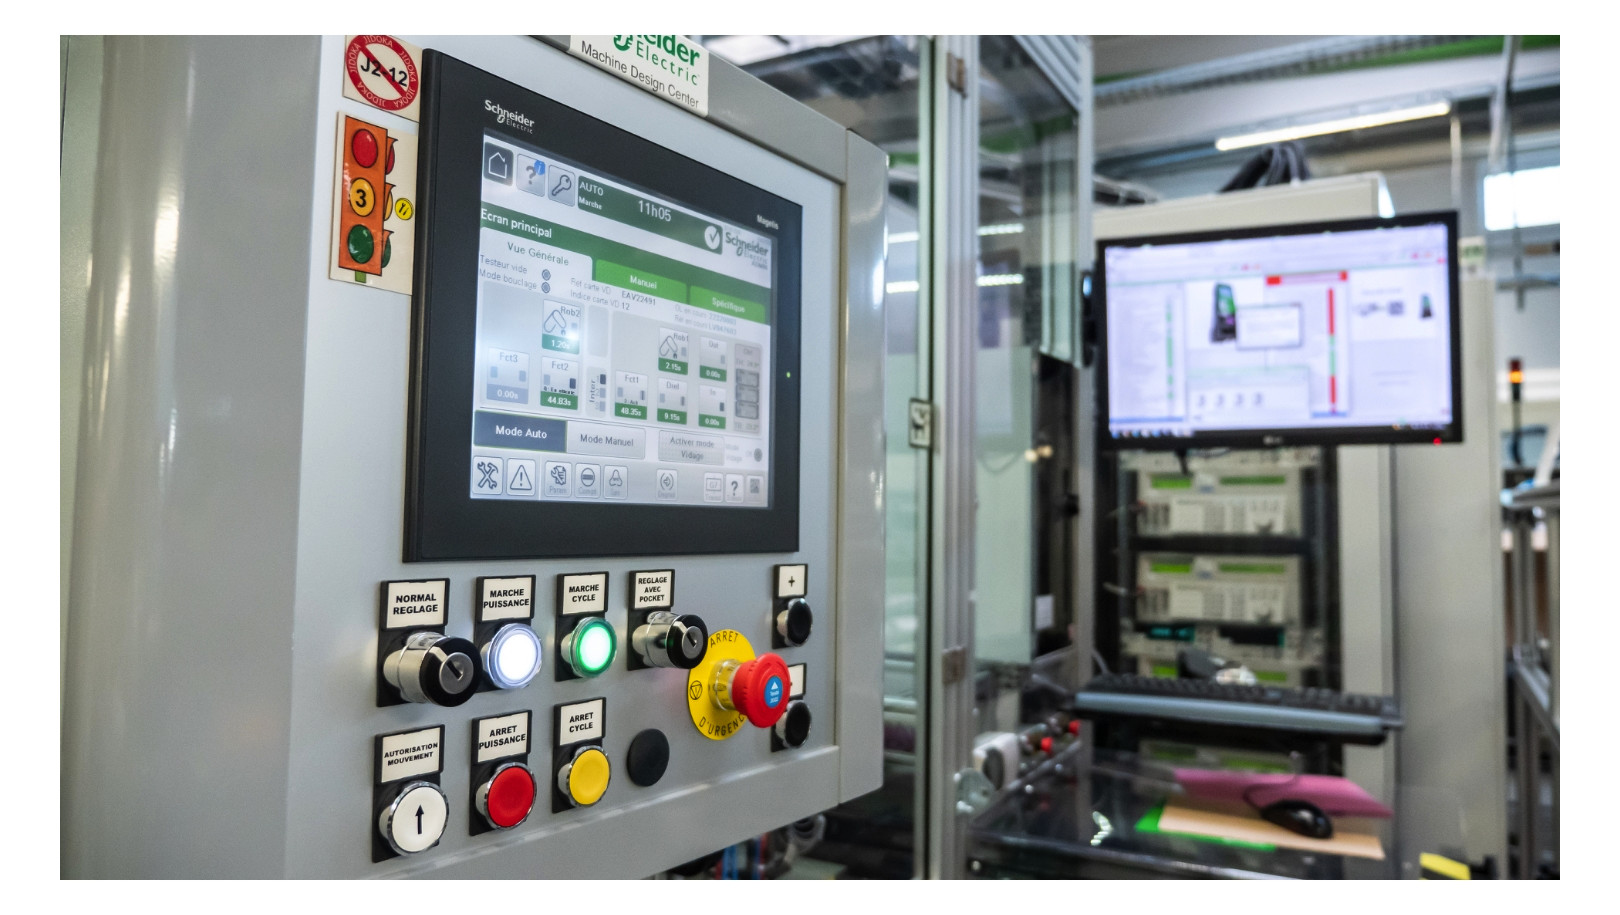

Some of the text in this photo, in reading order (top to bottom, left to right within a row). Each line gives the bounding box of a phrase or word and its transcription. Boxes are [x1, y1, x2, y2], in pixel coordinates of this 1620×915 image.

[363, 35, 393, 48] JIDOKA
[348, 43, 361, 73] JIDOKA
[637, 35, 700, 66] eider
[399, 51, 417, 82] JIDOKA
[636, 40, 698, 86] Electric
[581, 40, 699, 109] Machine Design Center
[357, 81, 386, 107] JIDOKA
[393, 86, 416, 107] JIDOKA
[484, 99, 535, 128] Schneider
[506, 118, 534, 135] Electric
[579, 181, 604, 196] AUTO
[355, 189, 367, 208] 3
[578, 196, 603, 210] Marche
[638, 199, 672, 222] 11h05
[511, 218, 553, 239] principal
[725, 231, 769, 257] Schneider
[507, 242, 569, 266] Vue Générale
[480, 254, 528, 274] Testeur vide
[479, 269, 537, 290] Mode bouclage
[629, 274, 657, 290] Manuel
[621, 302, 631, 310] 12
[495, 425, 548, 439] Mode Auto
[580, 434, 634, 447] Mode Manuel
[696, 440, 714, 448] mode
[568, 584, 599, 593] MARCHE
[638, 577, 667, 585] REGLAGE
[395, 593, 437, 604] NORMAL
[489, 588, 525, 598] MARCHE
[572, 594, 596, 602] CYCLE
[639, 594, 665, 603] POCKET
[393, 604, 438, 615] REGLAGE
[483, 598, 530, 609] PUISSANCE
[710, 630, 738, 648] ARRET
[569, 712, 594, 724] ARRET
[699, 713, 745, 737] D'URGENC
[489, 725, 518, 738] ARRET
[569, 721, 594, 733] CYCLE
[478, 733, 526, 750] PUISSANCE
[384, 742, 438, 758] AUTORISATION
[387, 751, 434, 767] MOUVEMENT
